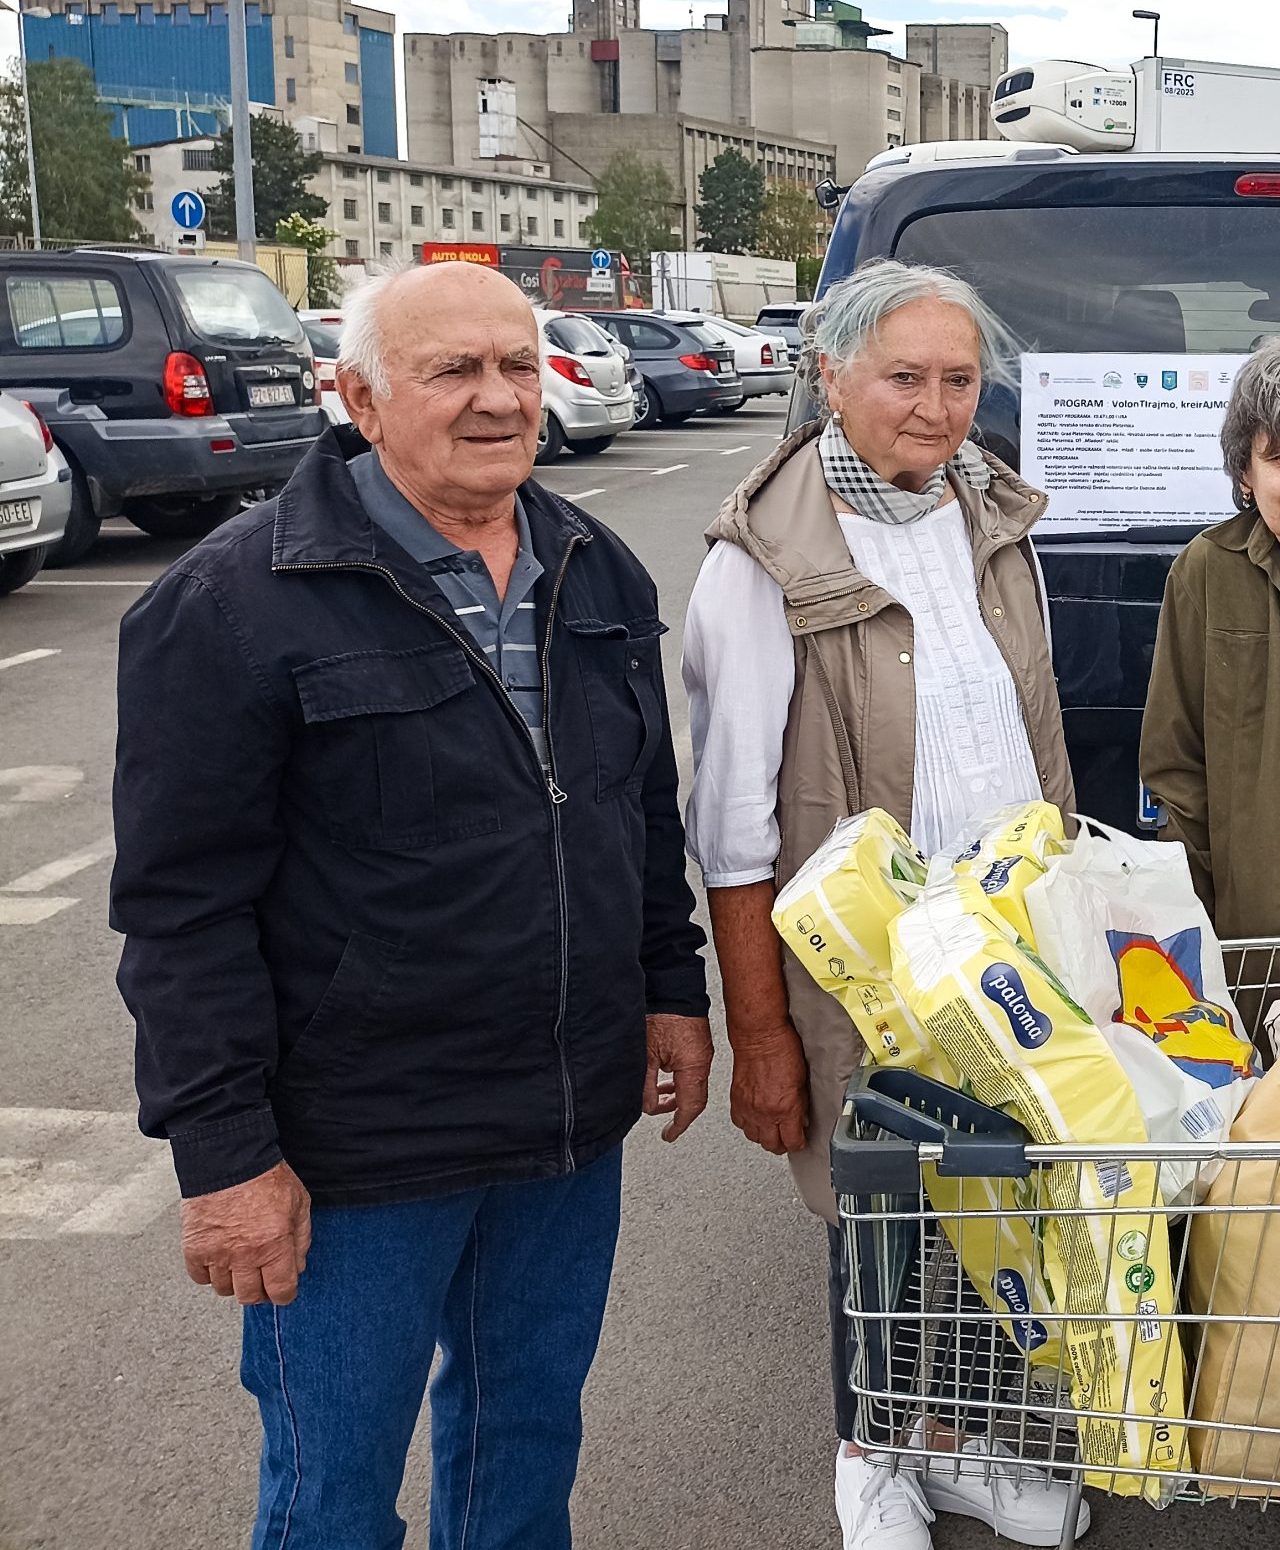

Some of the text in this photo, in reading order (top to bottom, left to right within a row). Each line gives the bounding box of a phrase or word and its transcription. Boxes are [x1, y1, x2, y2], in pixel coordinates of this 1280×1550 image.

[1164, 73, 1195, 87] FRC
[1164, 87, 1195, 96] 08/2023
[431, 252, 457, 262] AUTO
[1054, 399, 1104, 408] PROGRAM
[809, 934, 827, 953] 10
[988, 974, 1044, 1040] paloma
[1000, 1276, 1041, 1340] paoma
